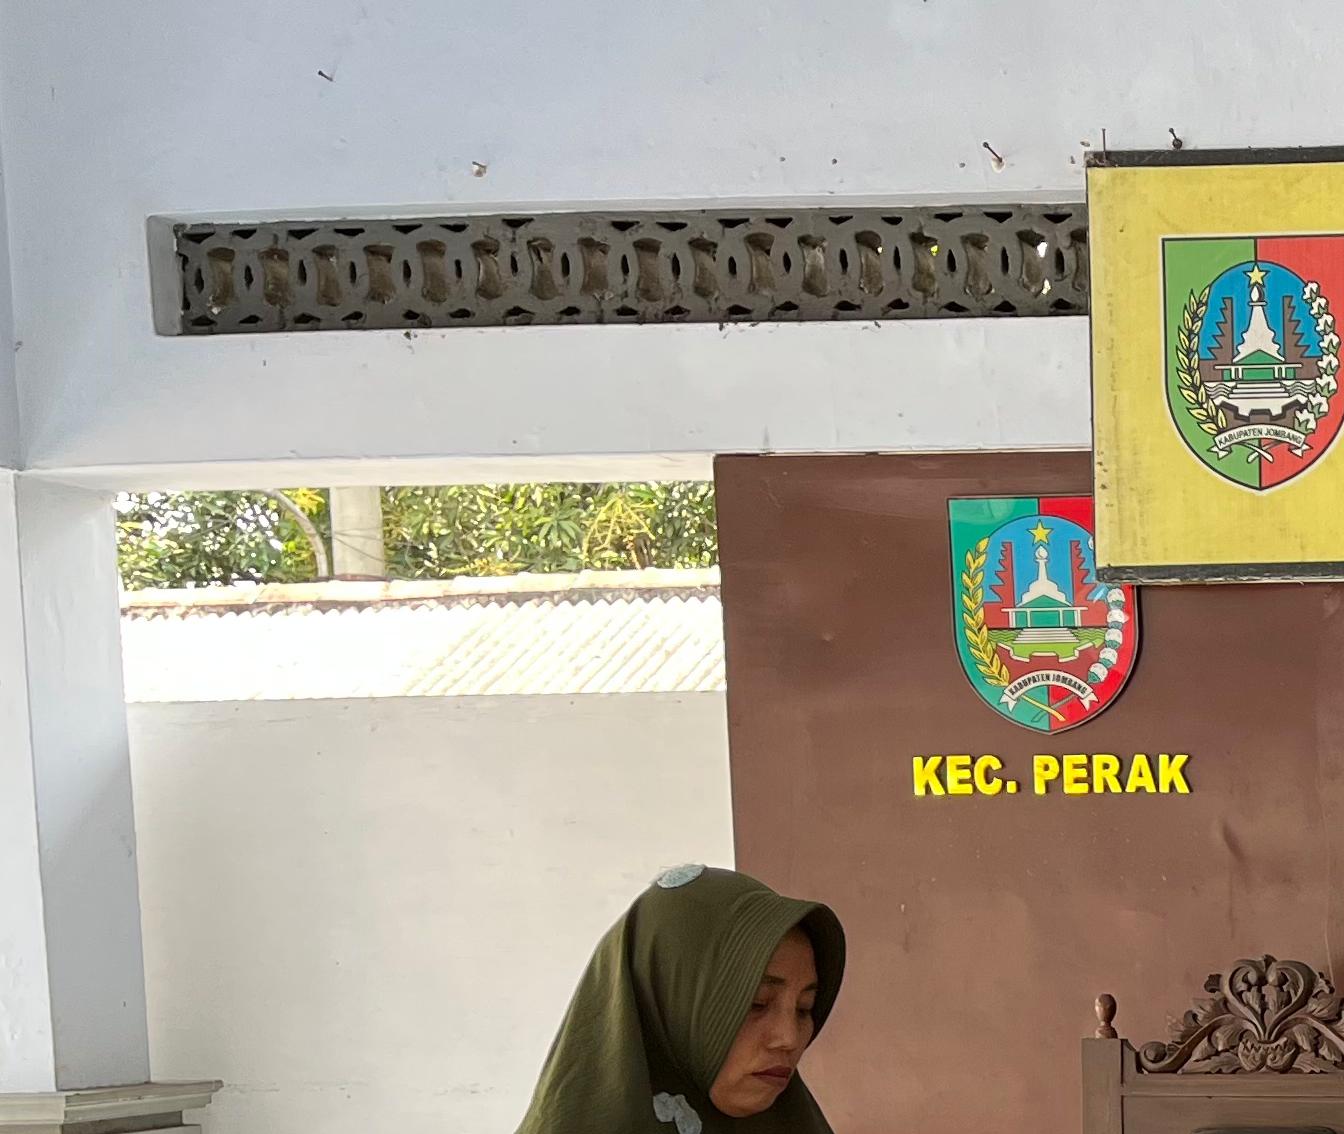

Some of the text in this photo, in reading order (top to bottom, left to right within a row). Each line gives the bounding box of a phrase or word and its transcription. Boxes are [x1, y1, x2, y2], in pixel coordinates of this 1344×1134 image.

[1218, 427, 1303, 446] KABUPATEN JOMBANG
[912, 754, 1190, 797] KEC. PERAK
